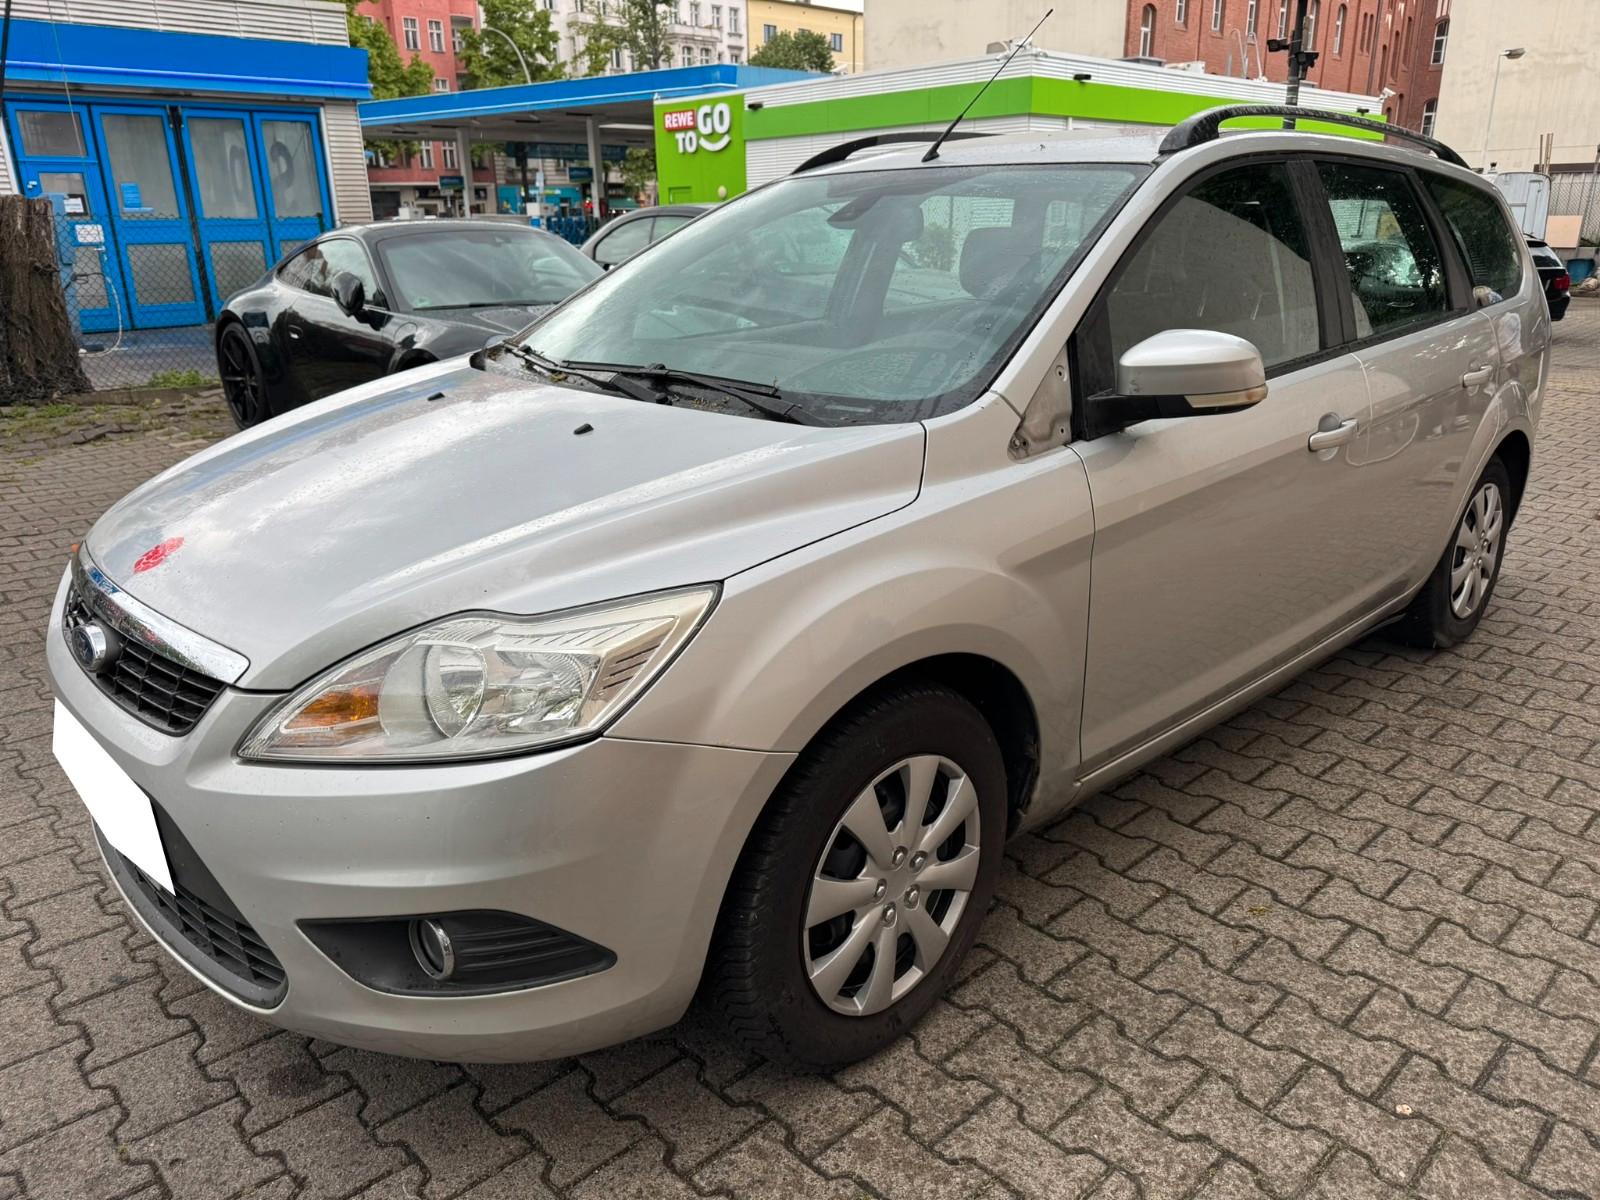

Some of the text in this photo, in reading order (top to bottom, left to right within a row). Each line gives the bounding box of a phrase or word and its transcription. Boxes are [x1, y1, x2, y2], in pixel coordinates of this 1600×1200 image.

[664, 111, 694, 129] REWE
[675, 103, 730, 153] TO GO
